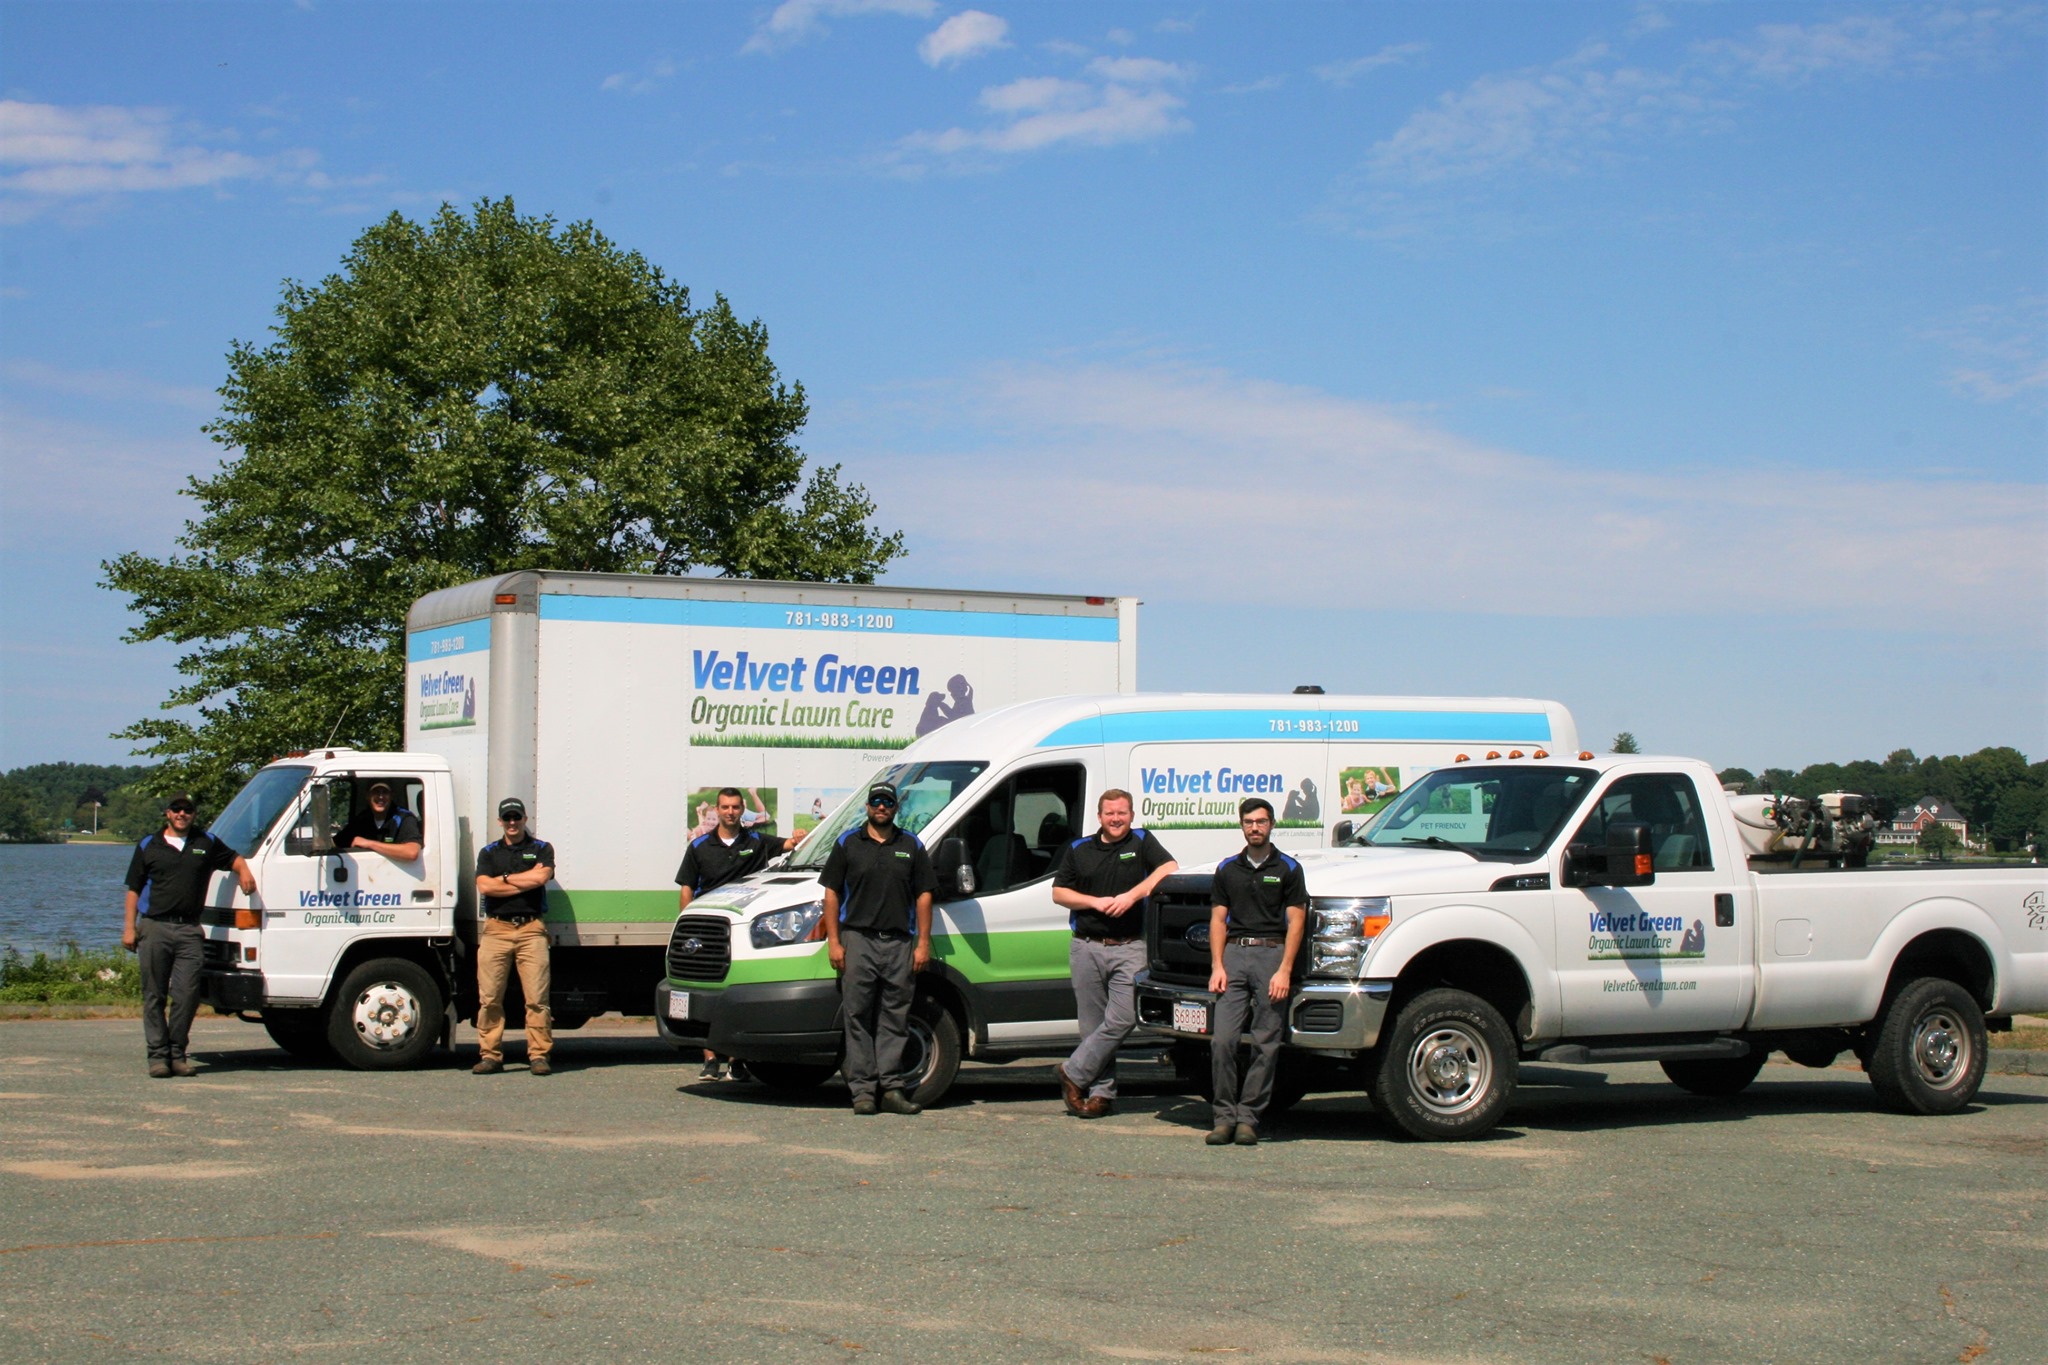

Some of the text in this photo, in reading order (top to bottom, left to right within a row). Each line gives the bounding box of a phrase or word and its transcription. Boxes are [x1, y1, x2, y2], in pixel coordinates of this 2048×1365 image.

[785, 610, 894, 630] 781-983-1200
[692, 649, 920, 696] Velvet Green
[420, 670, 464, 698] Velvet Green
[420, 699, 436, 722] Organic
[449, 698, 459, 716] Care
[690, 696, 894, 733] Organic Lawn Care
[1269, 719, 1360, 733] 781-983-1200
[1140, 767, 1284, 794] Velvet Green
[1141, 797, 1236, 821] Organic Lawn
[1420, 822, 1467, 830] PET FRIENDLY
[298, 888, 402, 909] Velvet Green
[303, 911, 395, 928] Organic Lawn Care
[1589, 911, 1682, 933] Velvet Green
[1588, 934, 1672, 953] Organic Lawn Care
[1603, 978, 1697, 992] VelvetGreenLawn.com
